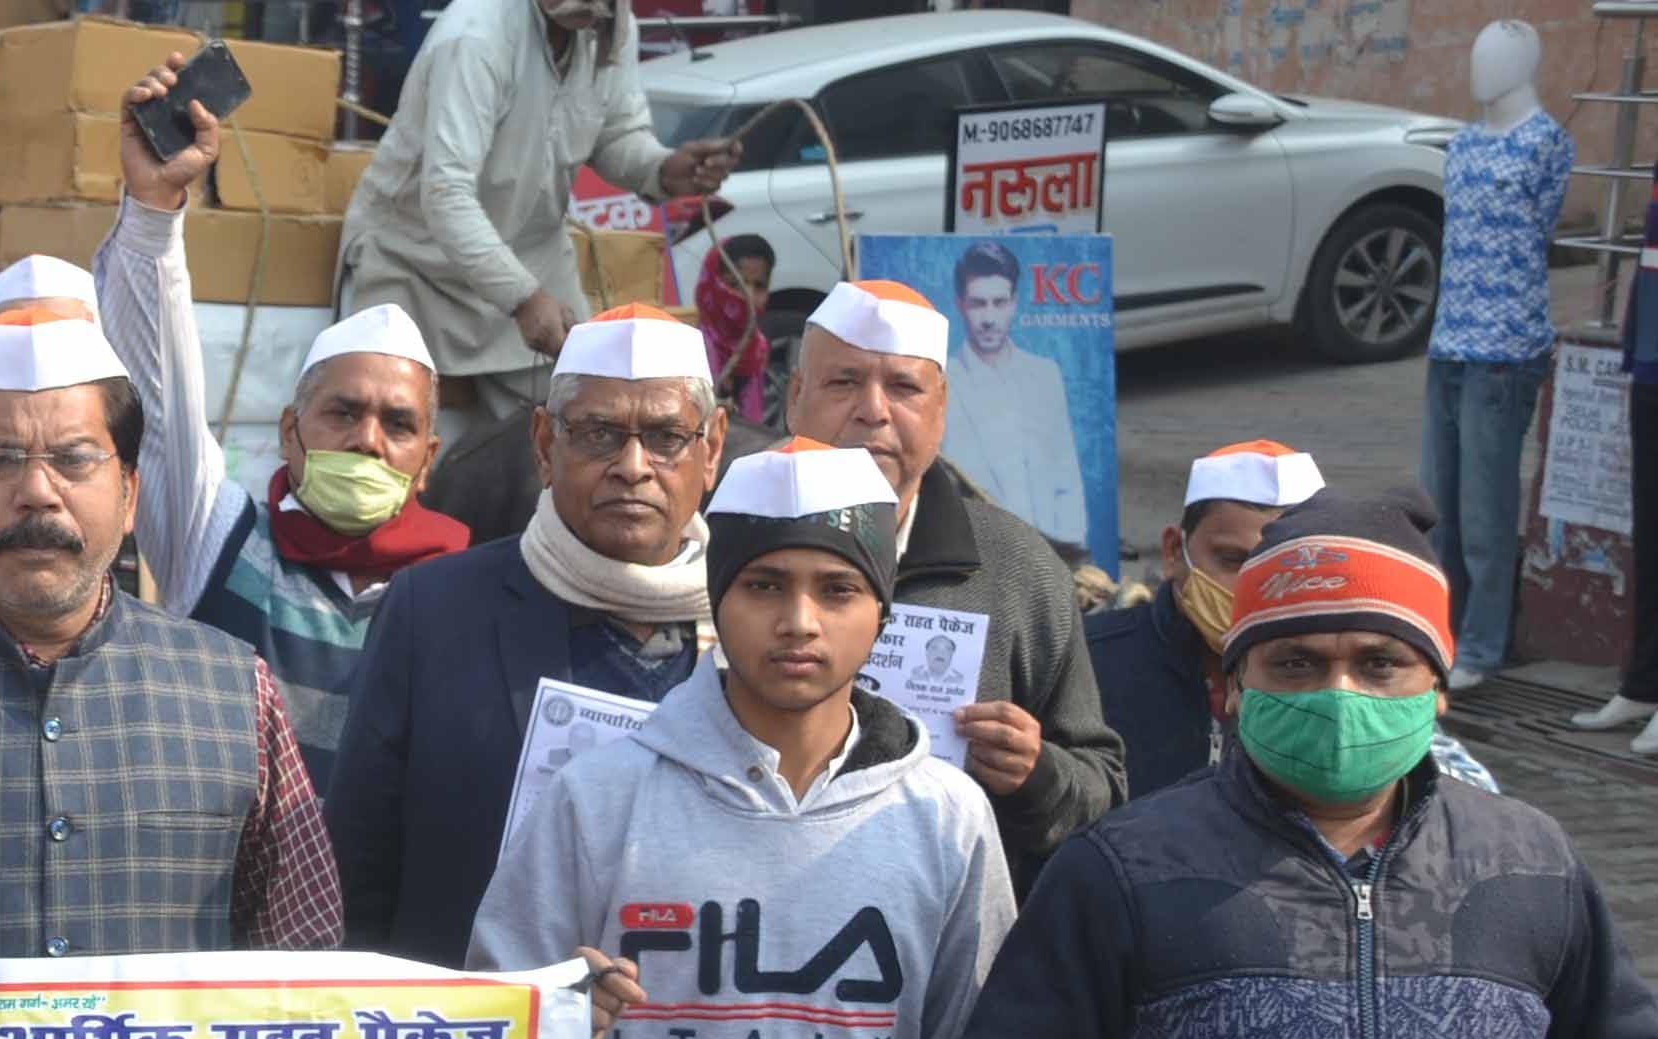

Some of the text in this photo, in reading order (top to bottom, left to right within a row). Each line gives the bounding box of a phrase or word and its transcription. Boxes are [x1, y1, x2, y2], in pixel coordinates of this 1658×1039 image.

[1031, 263, 1102, 306] KC
[1019, 311, 1112, 330] GARMENTS
[638, 908, 677, 922] FILA
[619, 898, 903, 1003] FILA
